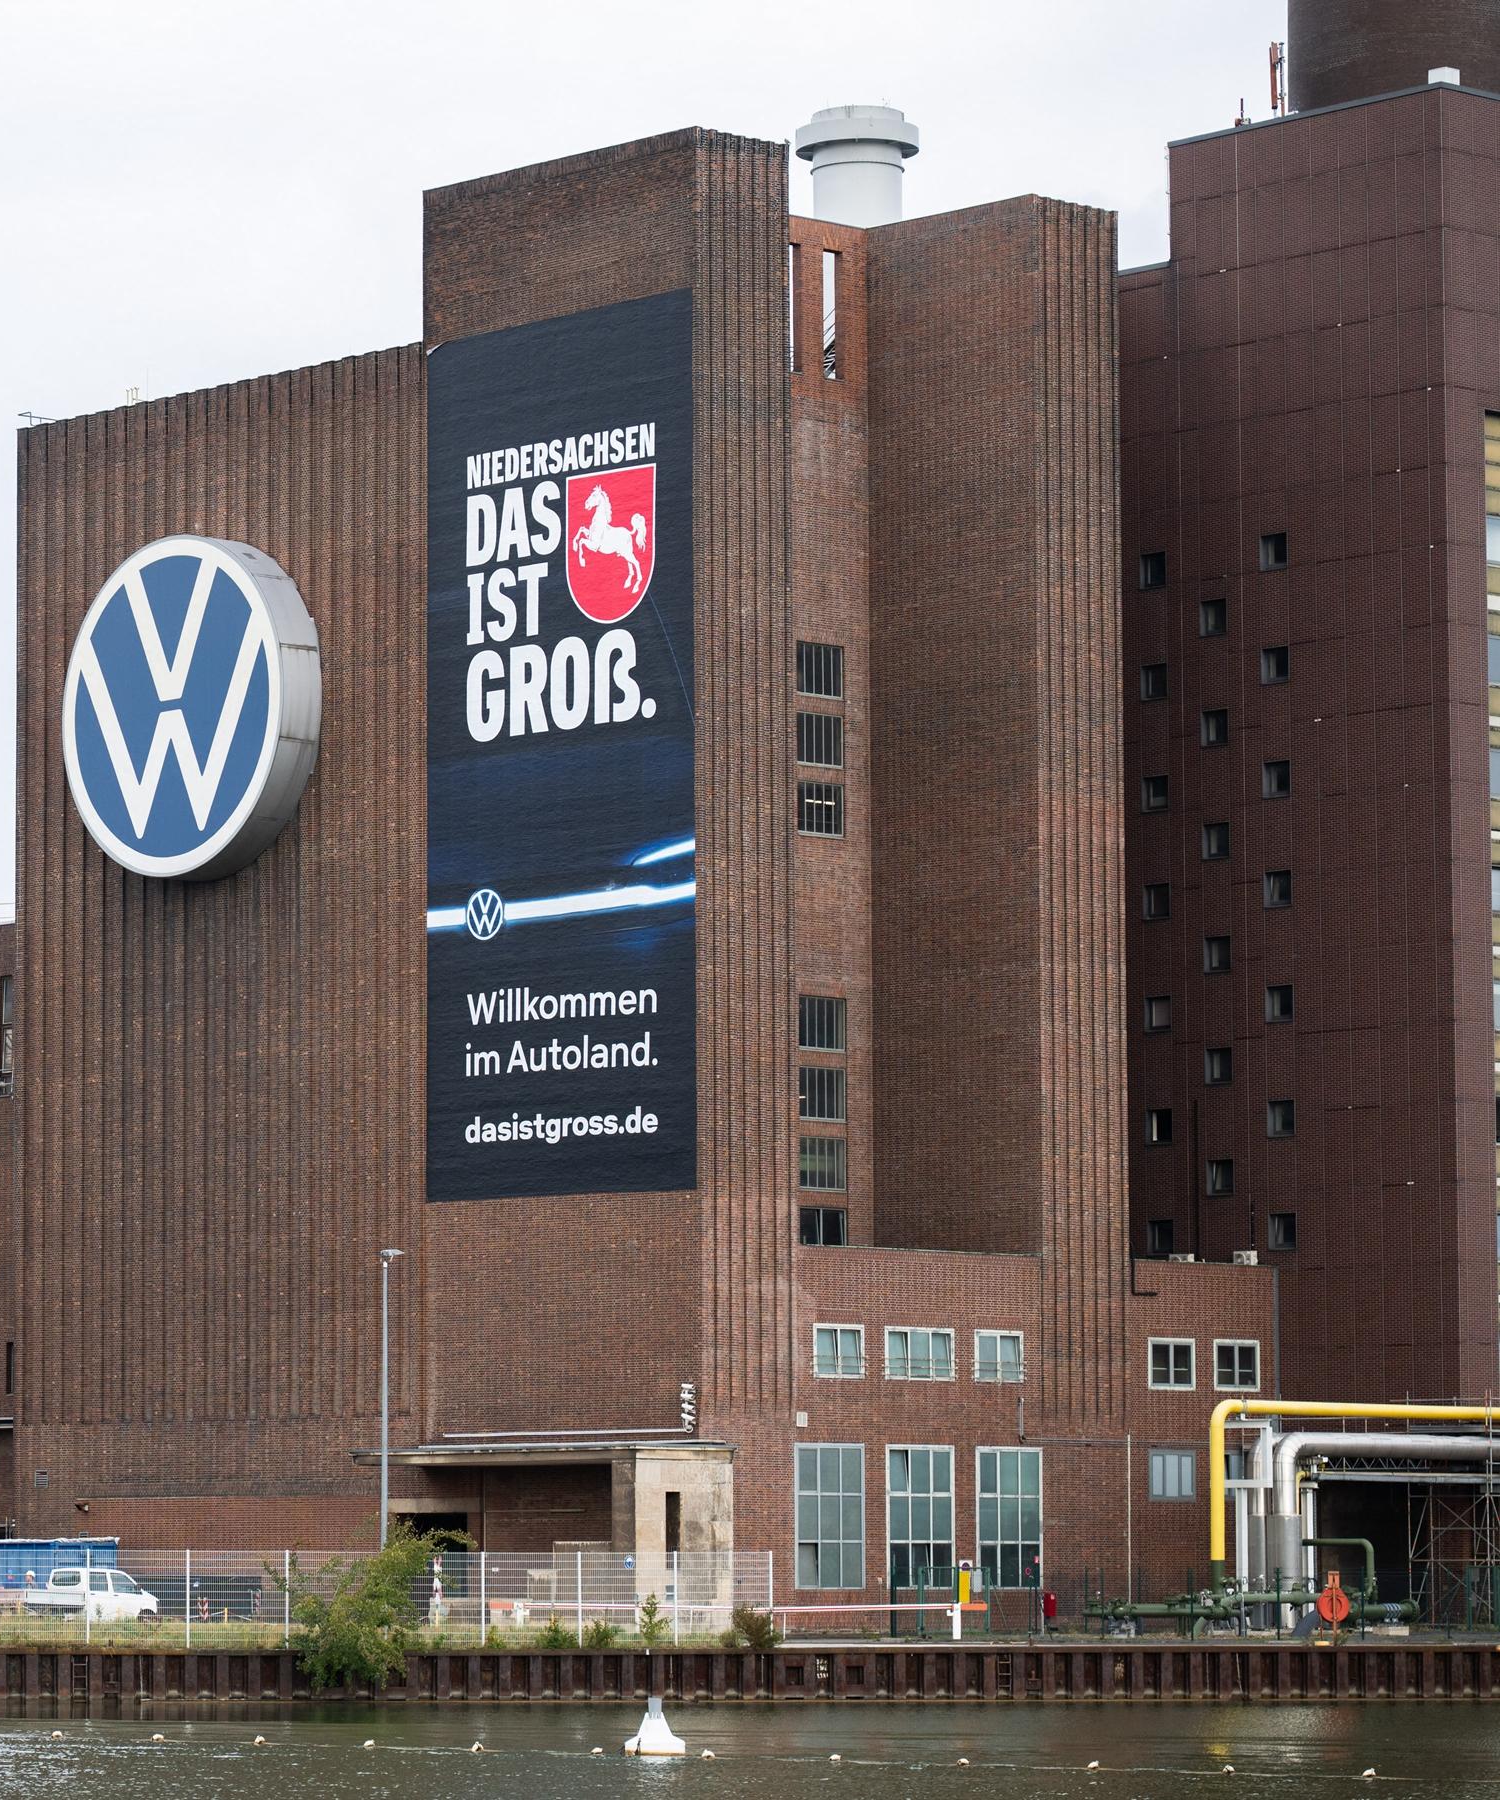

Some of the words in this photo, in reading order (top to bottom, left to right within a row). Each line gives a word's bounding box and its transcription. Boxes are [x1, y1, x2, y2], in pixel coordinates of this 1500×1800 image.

[466, 421, 656, 490] NIEDERSACHSEN
[465, 480, 562, 568] DAS
[466, 561, 549, 646] IST
[68, 542, 280, 868] VW
[466, 986, 658, 1026] Willkommen
[465, 1042, 501, 1077] im
[506, 1031, 659, 1074] Autoland.
[464, 1105, 659, 1144] dasistgross.de
